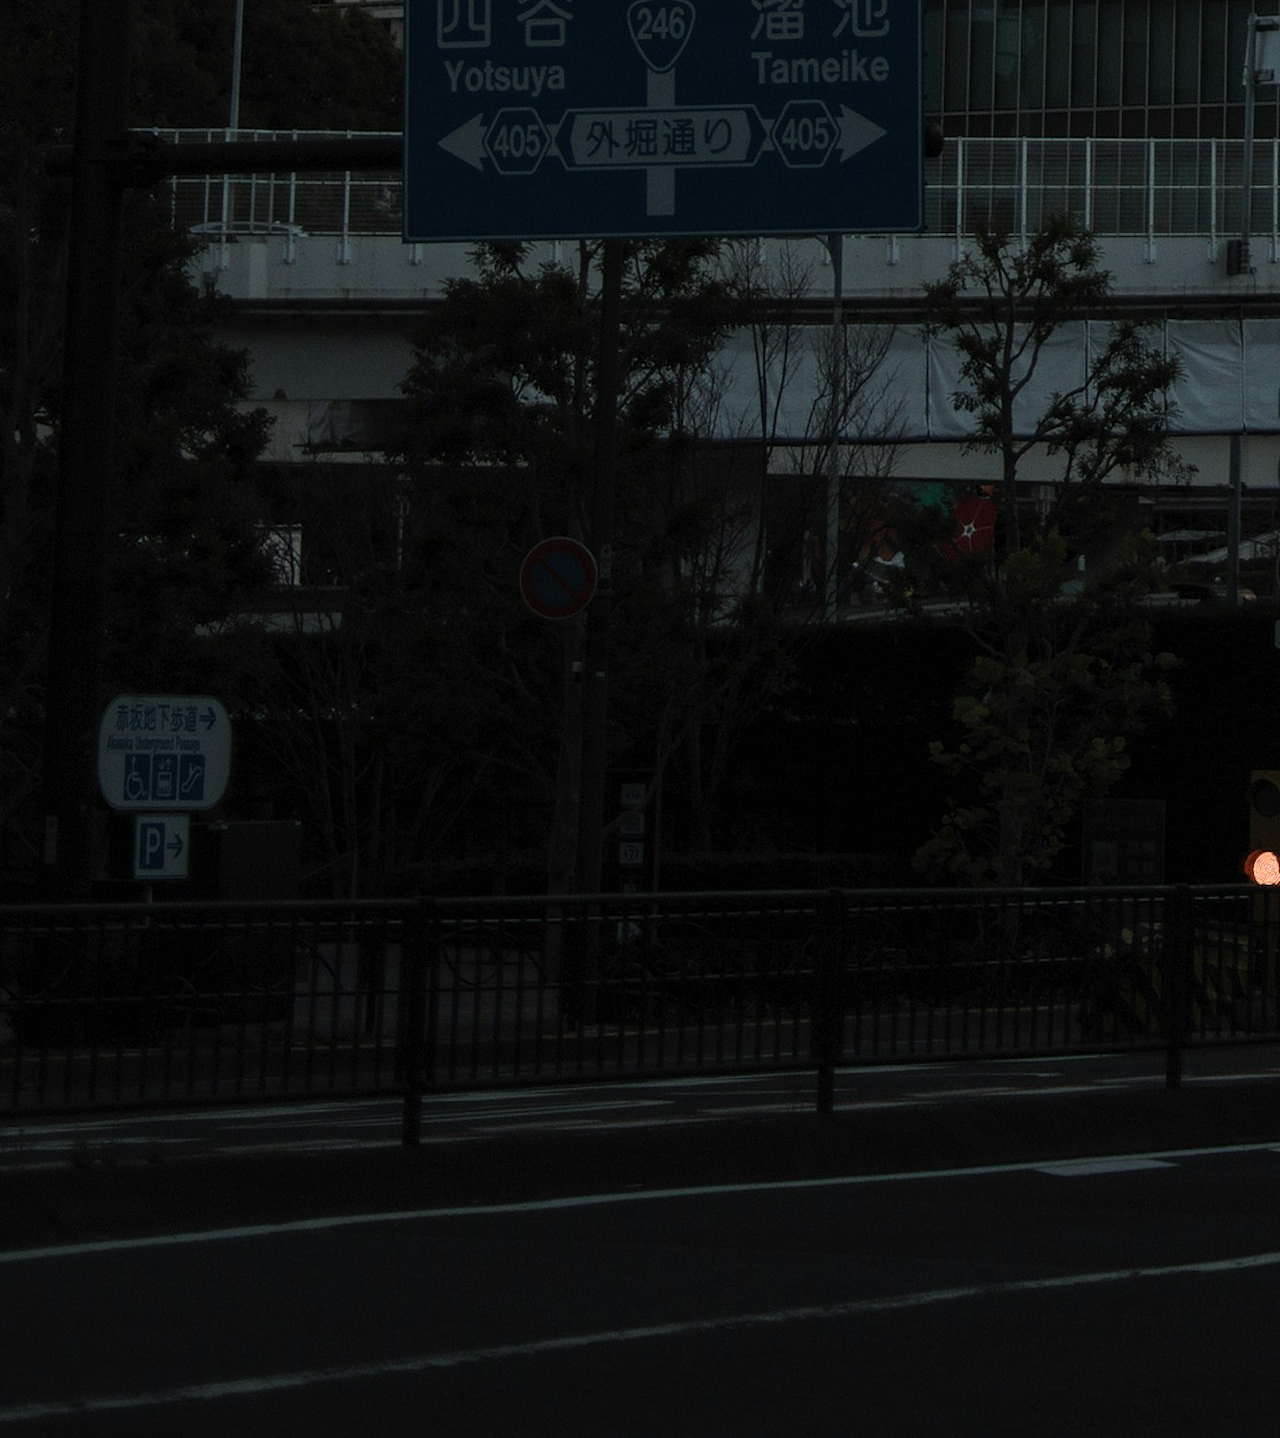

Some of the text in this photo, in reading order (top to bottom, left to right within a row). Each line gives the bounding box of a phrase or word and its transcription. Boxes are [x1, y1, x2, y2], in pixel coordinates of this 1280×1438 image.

[636, 7, 686, 41] 246
[444, 59, 566, 97] Yotsuya
[750, 51, 891, 85] Tameike
[493, 124, 542, 157] 405
[585, 119, 732, 158] 外堀通り
[781, 117, 831, 149] 405
[115, 703, 197, 732] 赤坂地下歩道
[146, 827, 161, 866] P
